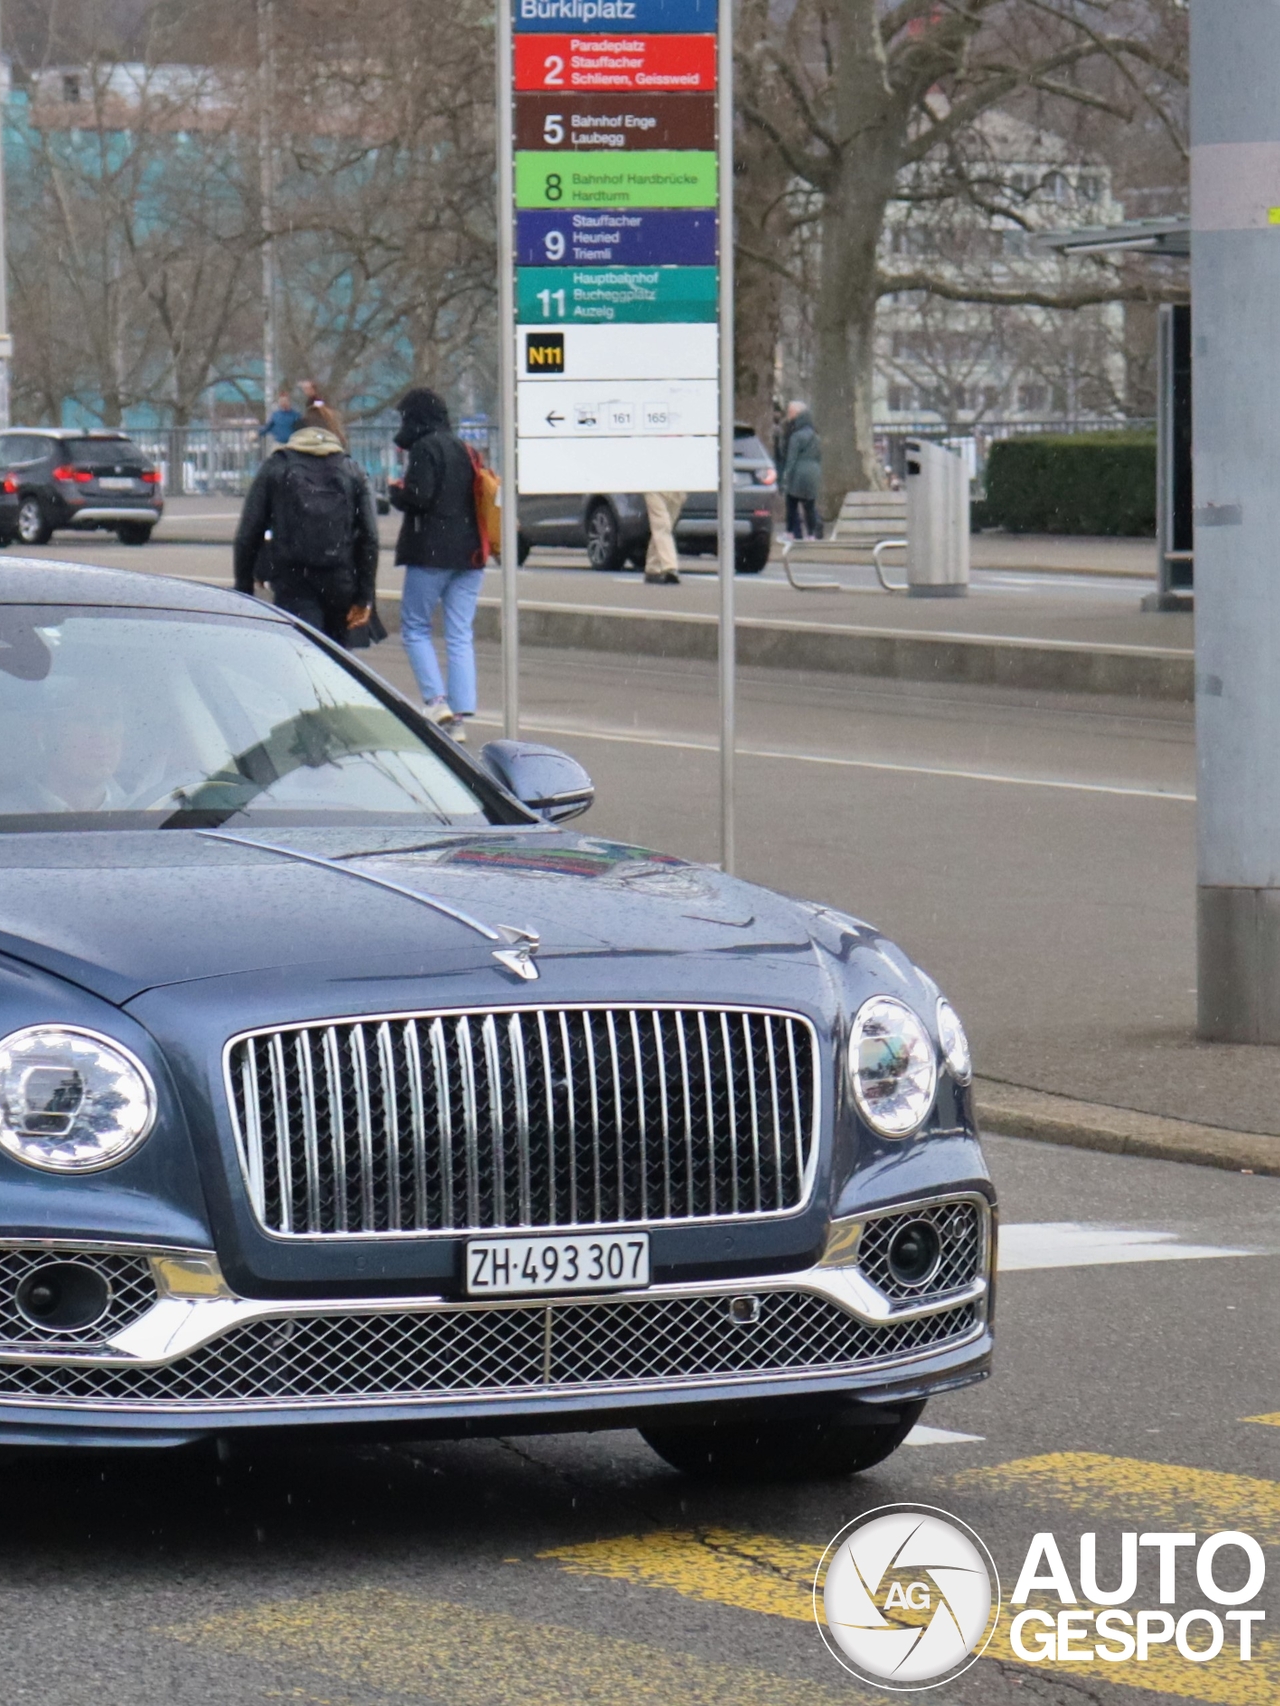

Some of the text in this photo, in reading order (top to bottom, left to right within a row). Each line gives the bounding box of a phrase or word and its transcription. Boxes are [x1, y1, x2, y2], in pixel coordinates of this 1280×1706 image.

[520, 0, 636, 22] Bürkliplatz
[570, 39, 645, 53] Paradeplatz
[570, 56, 644, 68] Stauffacher
[543, 55, 564, 85] 2
[570, 72, 700, 86] Schlieren, Geissweid
[543, 114, 564, 145] 5
[571, 115, 657, 130] Bahnhof Enge
[571, 133, 625, 146] Laubegg
[572, 173, 698, 185] Bahnhof Hardbrücke
[545, 173, 563, 201] 8
[572, 190, 630, 201] Hardturm
[572, 215, 643, 228] Stauffacher
[573, 231, 620, 244] Heuried
[544, 231, 566, 261] 9
[573, 248, 612, 260] Triemli
[573, 272, 659, 286] Hauptbahnhof
[536, 289, 566, 318] 11
[573, 306, 615, 320] Auzelg
[528, 347, 562, 365] N11
[612, 413, 631, 424] 161
[646, 413, 667, 424] 165
